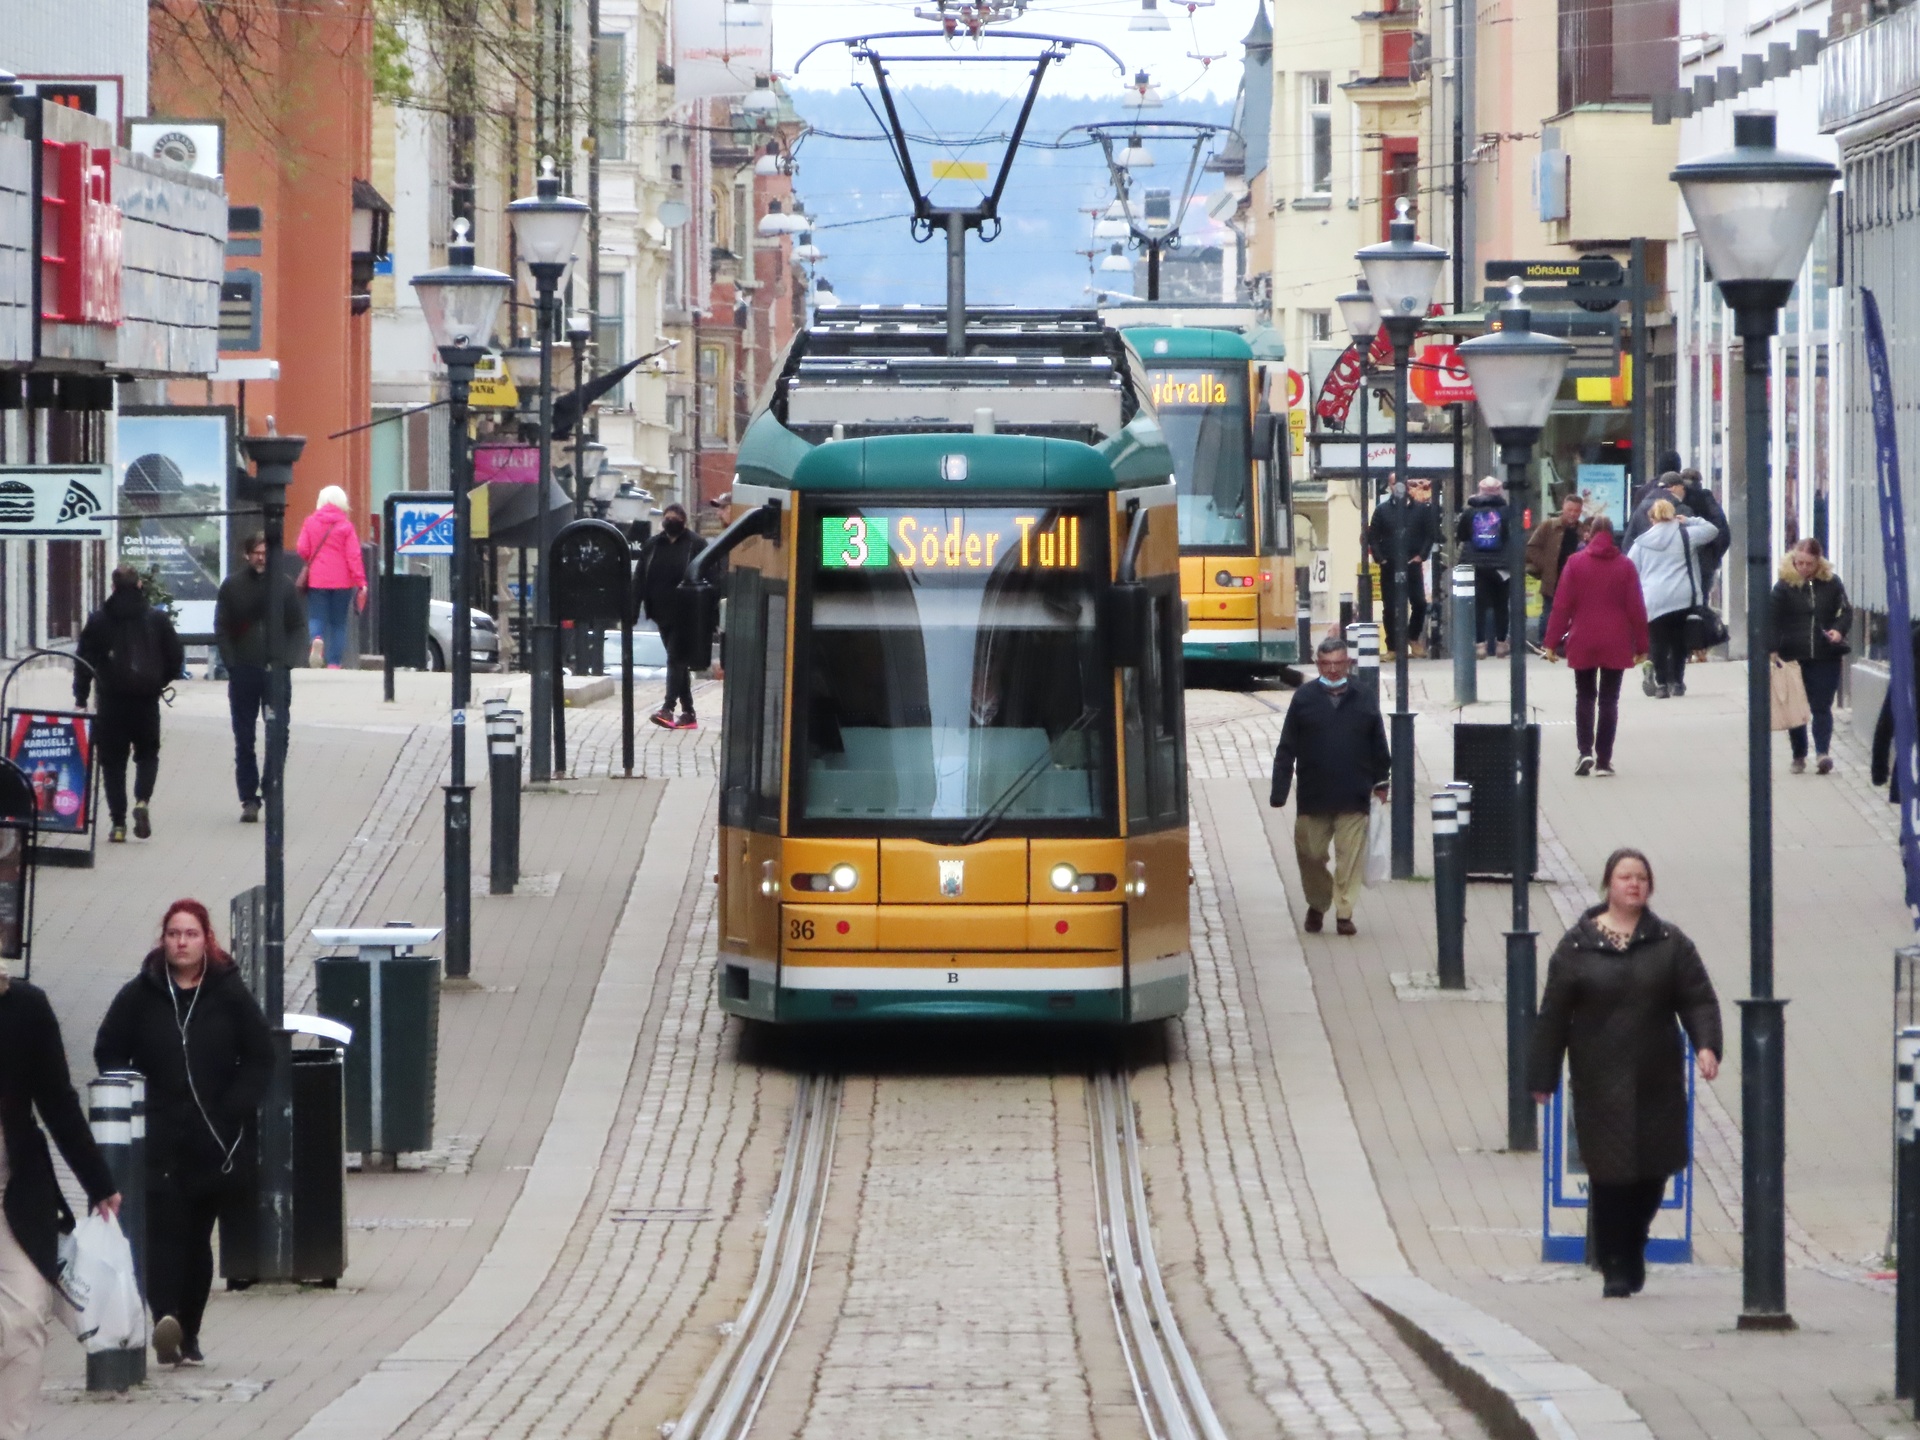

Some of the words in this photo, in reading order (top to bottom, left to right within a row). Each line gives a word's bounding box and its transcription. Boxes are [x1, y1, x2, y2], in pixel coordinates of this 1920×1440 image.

[1526, 265, 1580, 275] HÖRSALEN
[123, 536, 143, 545] Det
[840, 516, 869, 567] 3
[897, 516, 1000, 567] Söder
[1015, 517, 1078, 567] Tull
[32, 728, 50, 738] SOM
[52, 727, 65, 737] EN
[24, 738, 67, 748] KARUSELL
[789, 919, 815, 941] 36
[946, 972, 959, 984] B
